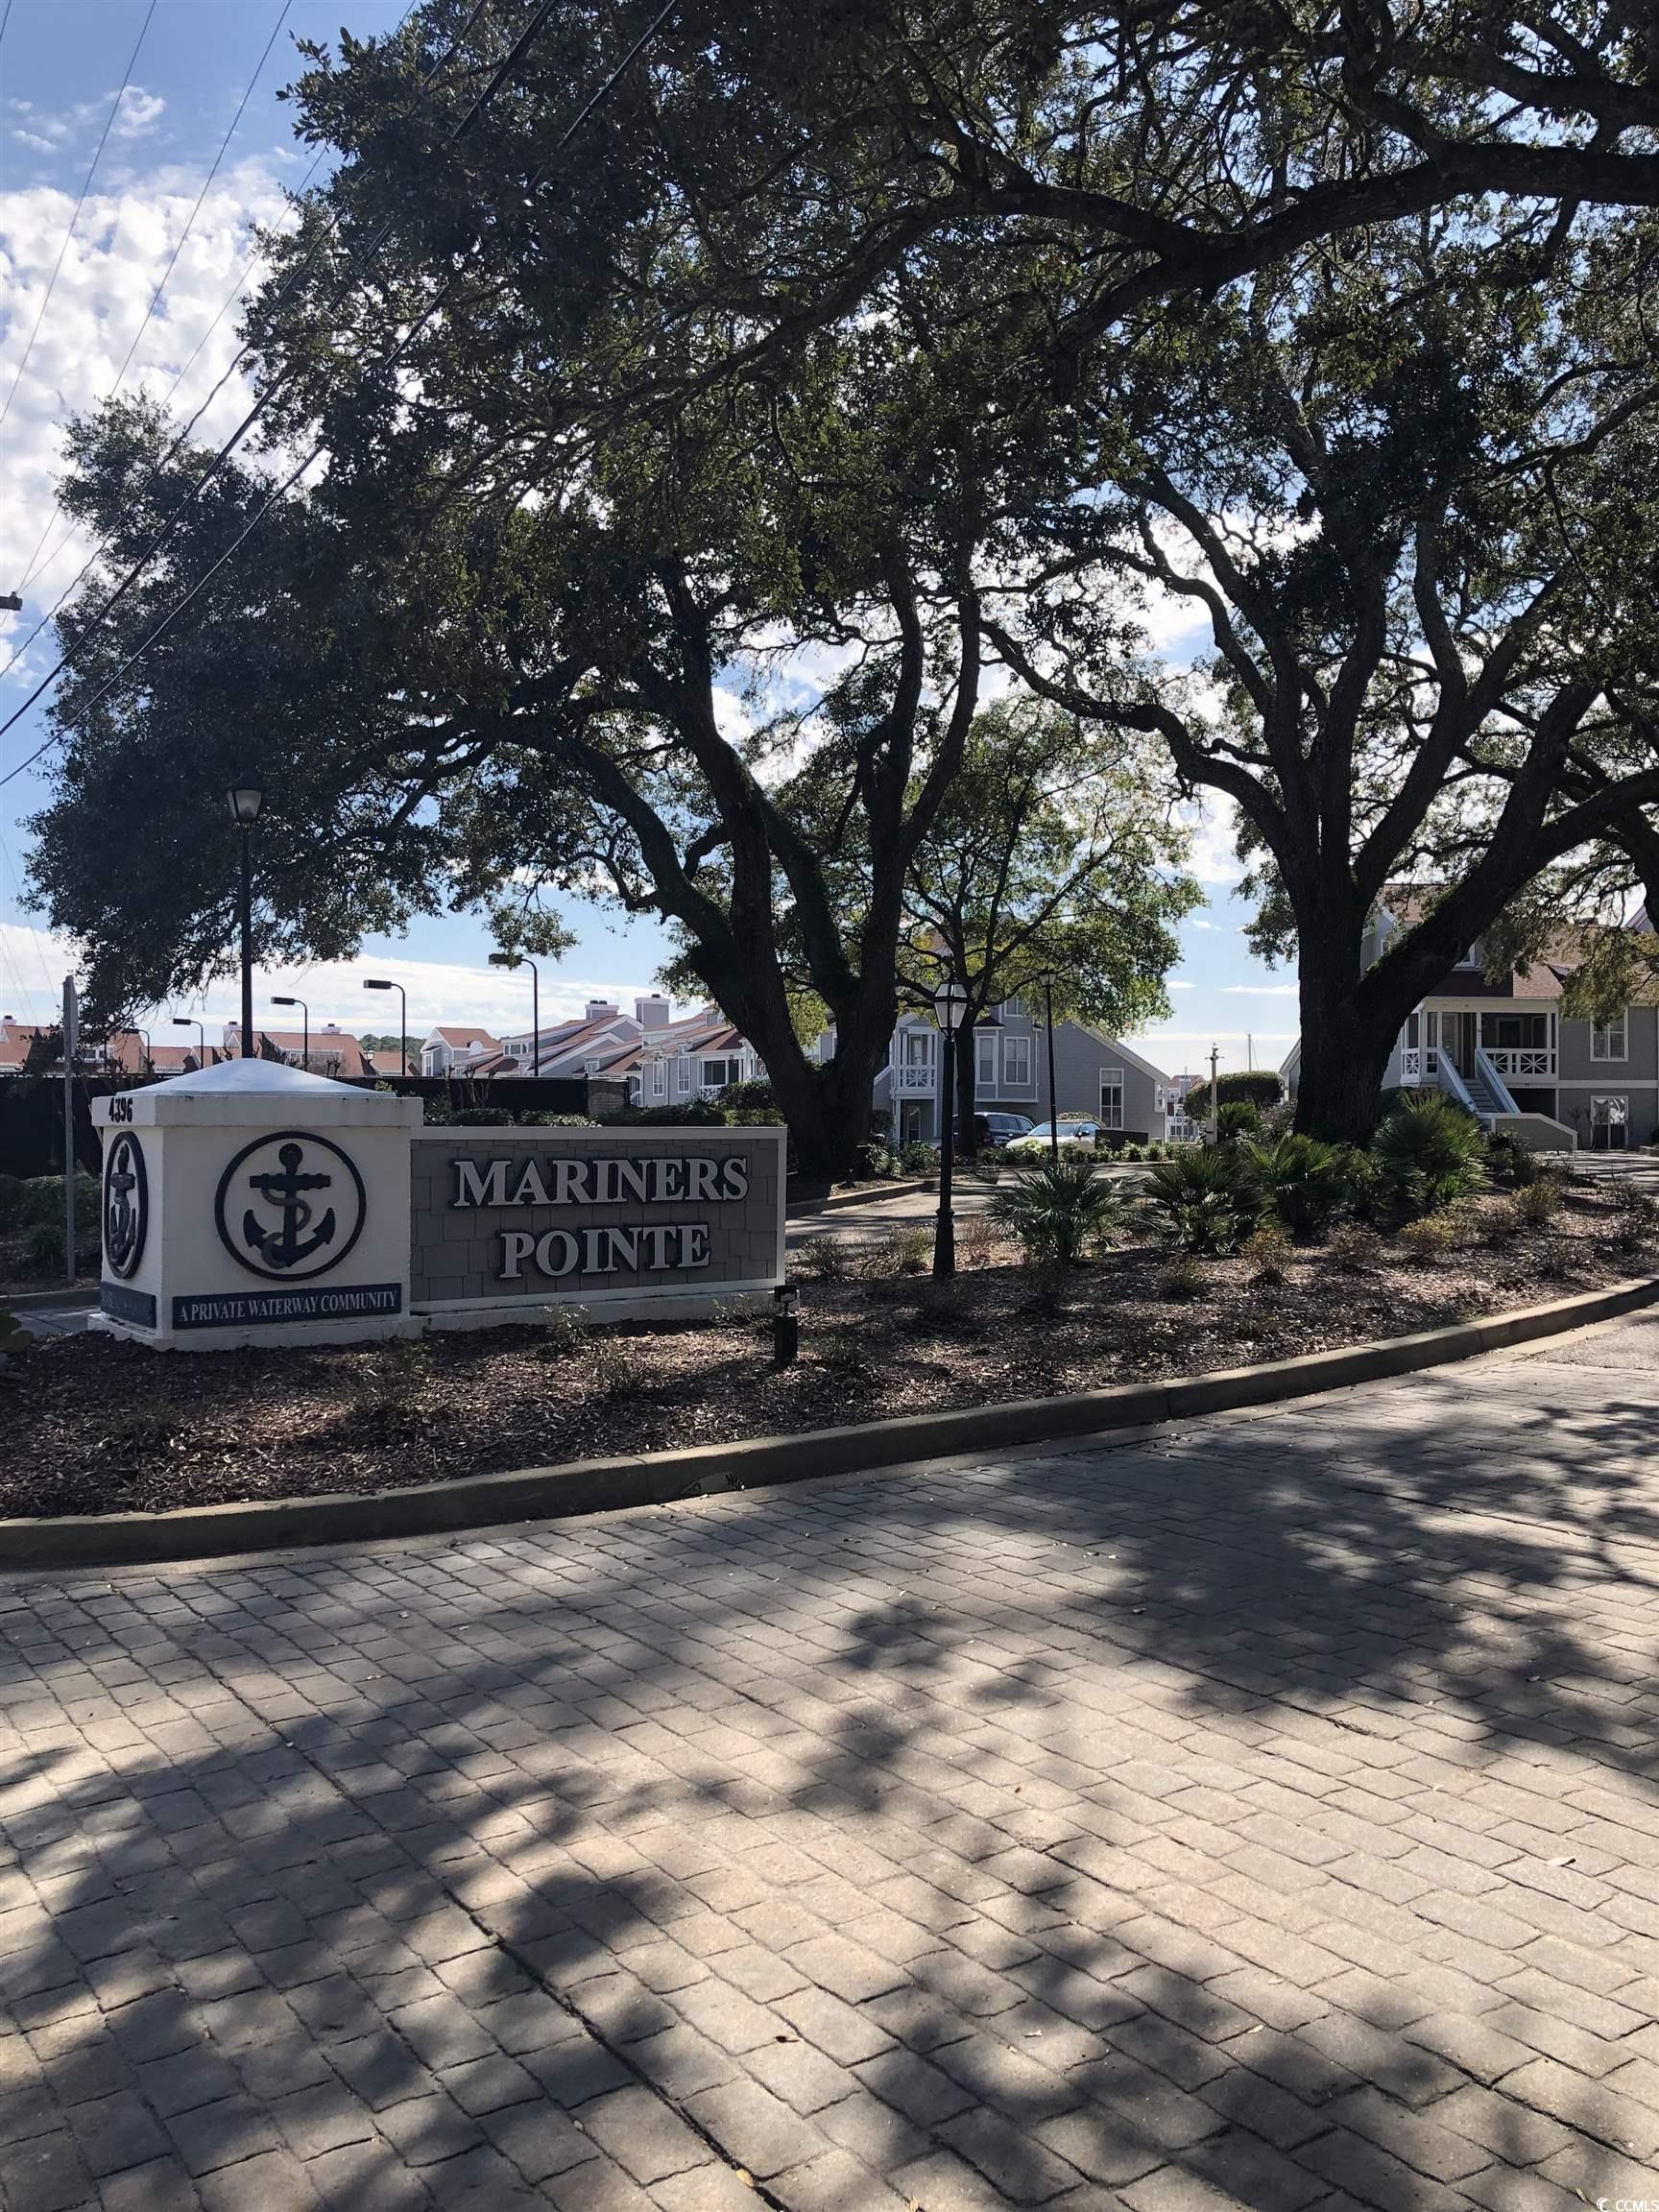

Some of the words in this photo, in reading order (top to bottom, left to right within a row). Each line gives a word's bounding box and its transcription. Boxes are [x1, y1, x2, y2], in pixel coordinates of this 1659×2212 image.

[108, 1096, 132, 1122] 4396
[452, 1156, 750, 1208] MARINERS
[499, 1223, 711, 1280] POINTE
[180, 1305, 189, 1322] A
[191, 1300, 246, 1321] PRIVATE
[248, 1295, 320, 1317] WATERWAY
[320, 1289, 397, 1312] COMMUNITY
